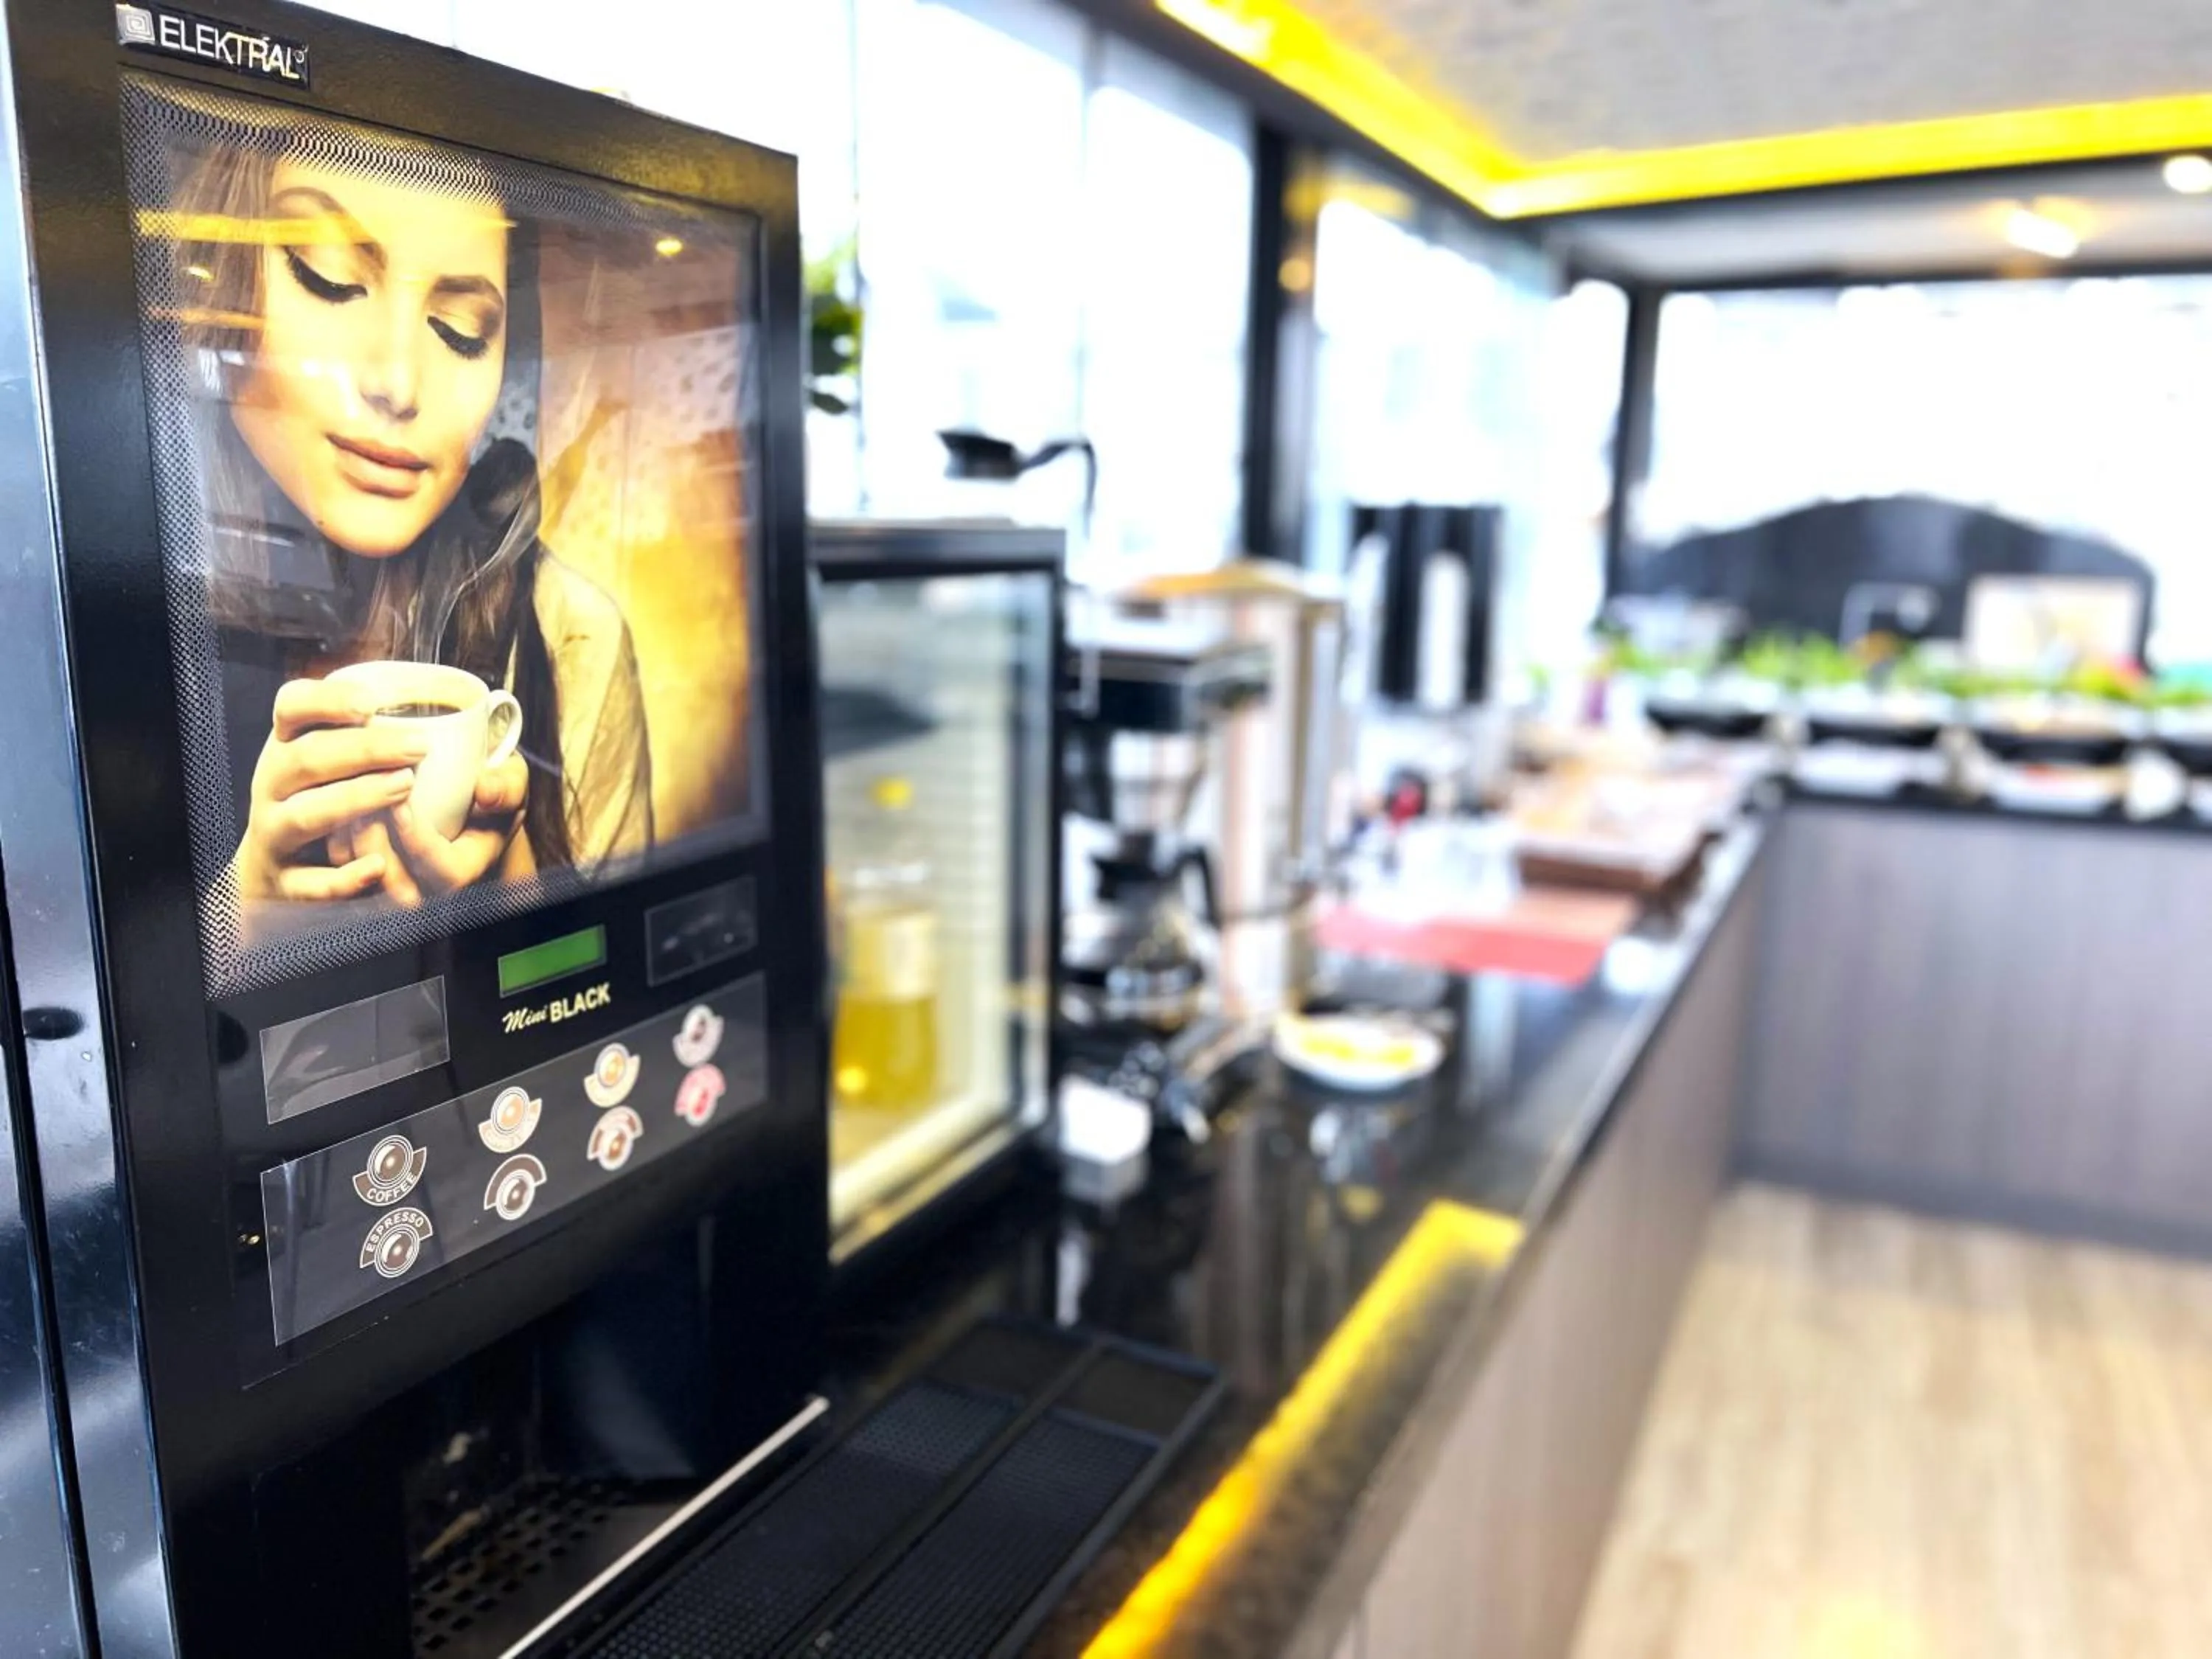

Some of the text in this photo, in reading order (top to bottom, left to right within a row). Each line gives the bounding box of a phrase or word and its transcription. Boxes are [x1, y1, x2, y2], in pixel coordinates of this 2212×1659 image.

[159, 14, 300, 79] ELEKTRAL
[502, 981, 611, 1034] Mini BLACK
[366, 1173, 417, 1203] COFFEE
[366, 1213, 424, 1253] ESPRESSO
